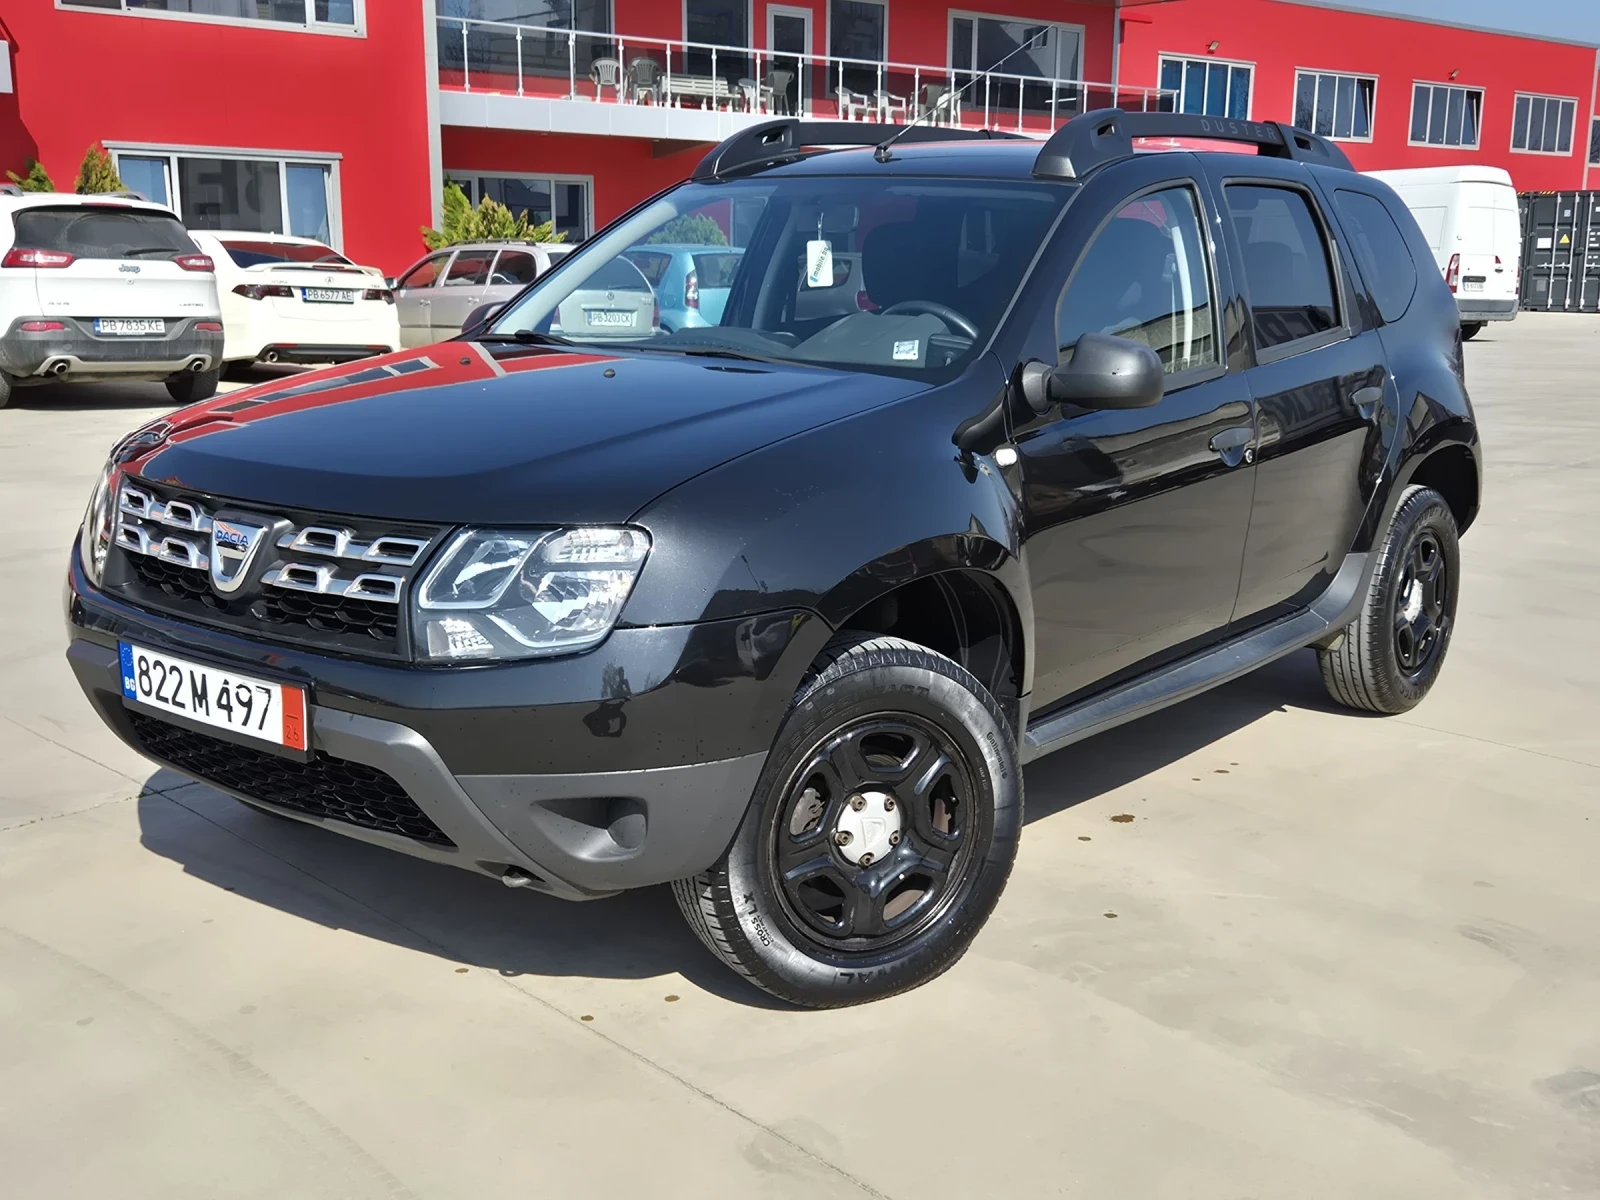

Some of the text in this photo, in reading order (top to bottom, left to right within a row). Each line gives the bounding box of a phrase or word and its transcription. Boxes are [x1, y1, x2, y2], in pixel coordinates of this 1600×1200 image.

[1201, 119, 1277, 140] DUSTER
[118, 263, 141, 275] Jeep
[307, 289, 352, 301] PB 6577 AE
[102, 319, 163, 331] PB 7835 KE
[593, 312, 631, 323] PB 3203 CK
[215, 530, 249, 546] DACIA
[124, 676, 136, 692] BG
[137, 655, 272, 731] 822 M 497
[285, 724, 300, 742] 26
[743, 891, 770, 947] CROSS LX
